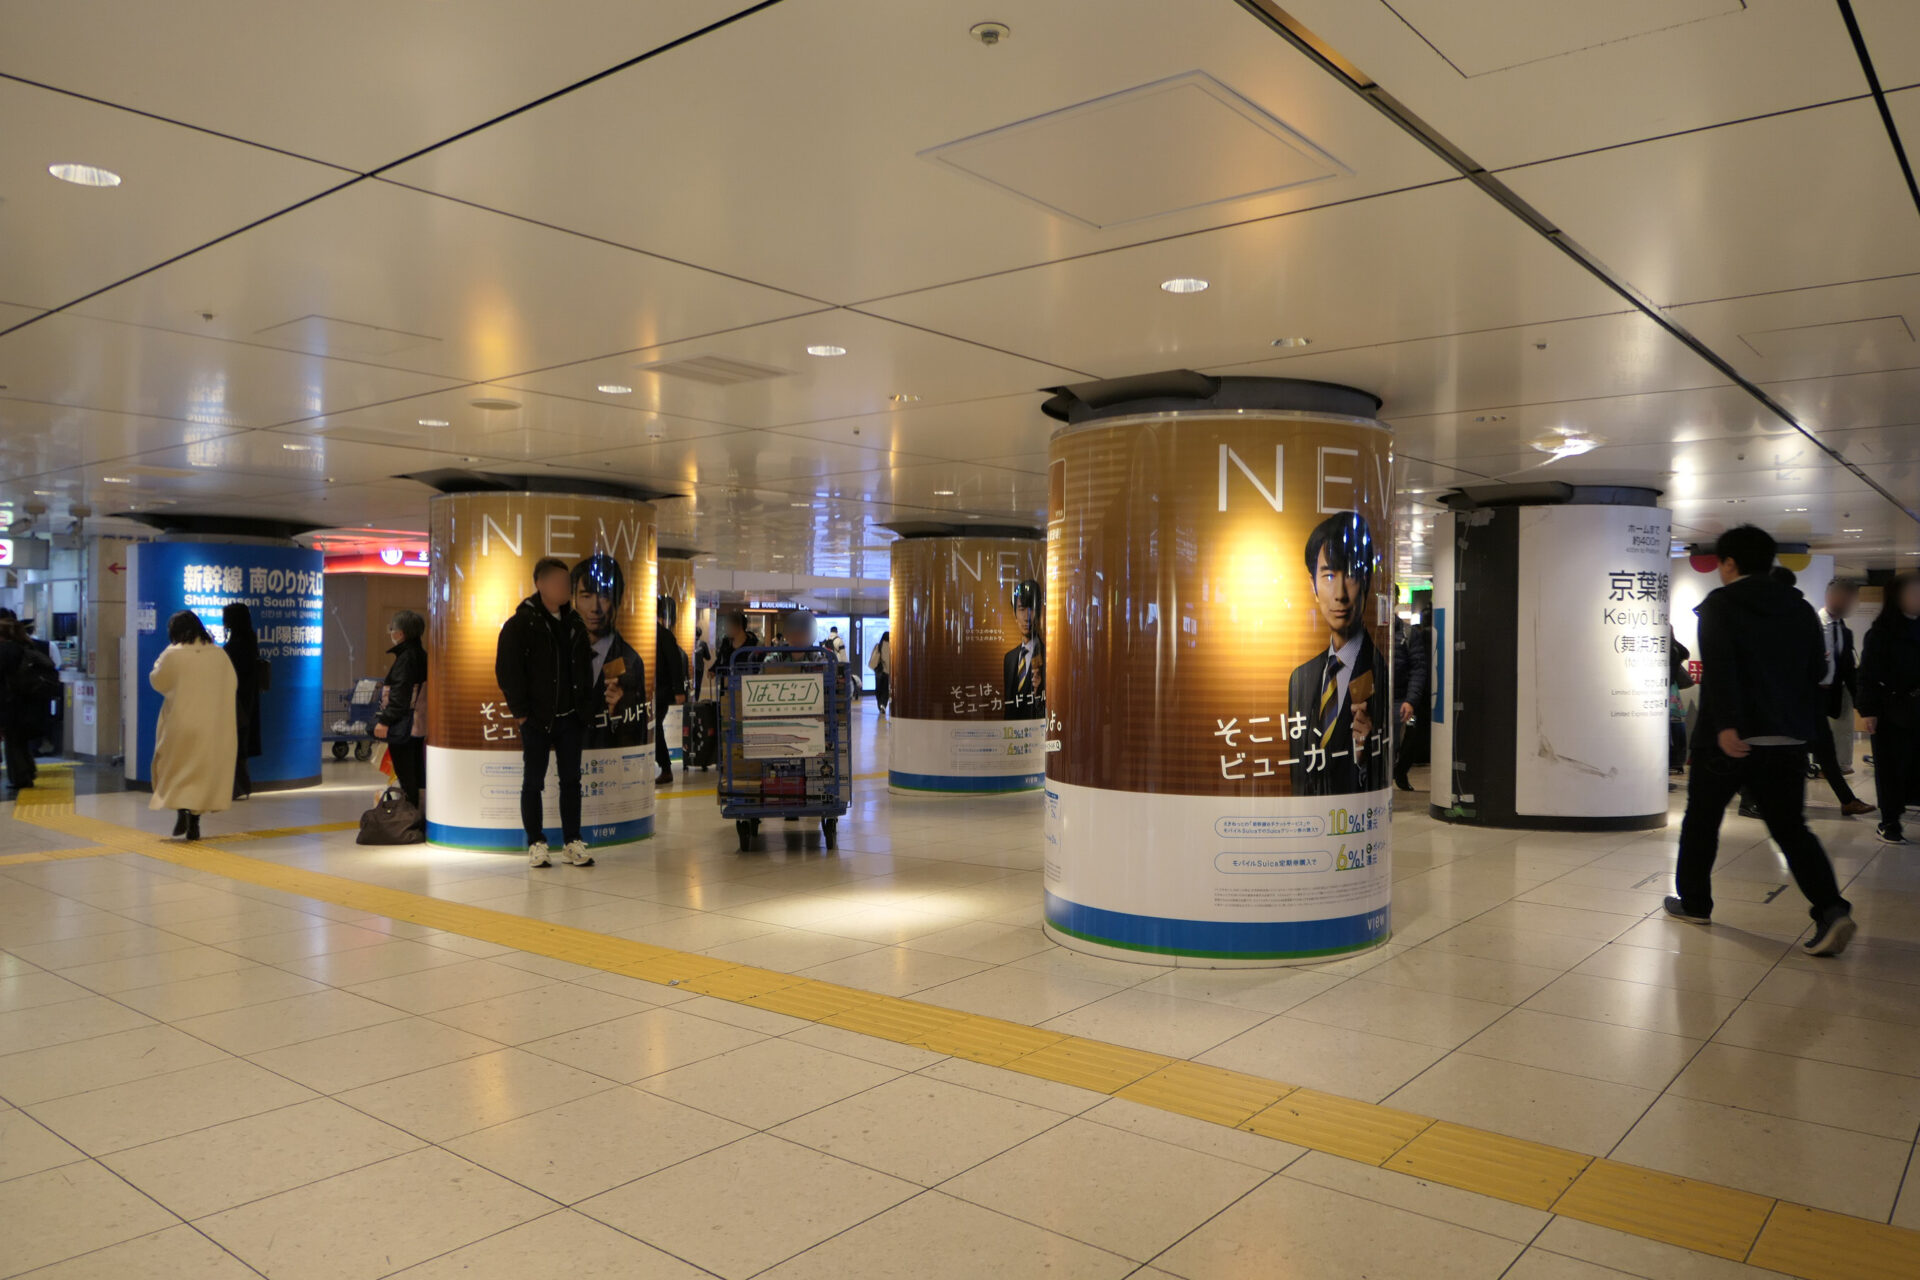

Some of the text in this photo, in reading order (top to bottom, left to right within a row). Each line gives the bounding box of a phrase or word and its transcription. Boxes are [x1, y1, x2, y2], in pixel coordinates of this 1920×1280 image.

[483, 513, 640, 561] NEW
[183, 564, 323, 596] 新幹線 南のりかえ口
[1608, 570, 1669, 602] 京葉線
[263, 596, 296, 608] South
[1603, 608, 1648, 629] Keiyō
[259, 647, 280, 658] nyō
[951, 683, 1000, 699] そこは、
[1214, 711, 1322, 747] そこは、
[592, 827, 616, 837] view
[1329, 808, 1365, 835] 10%!
[1336, 844, 1365, 870] 6%!
[1367, 913, 1386, 931] view
